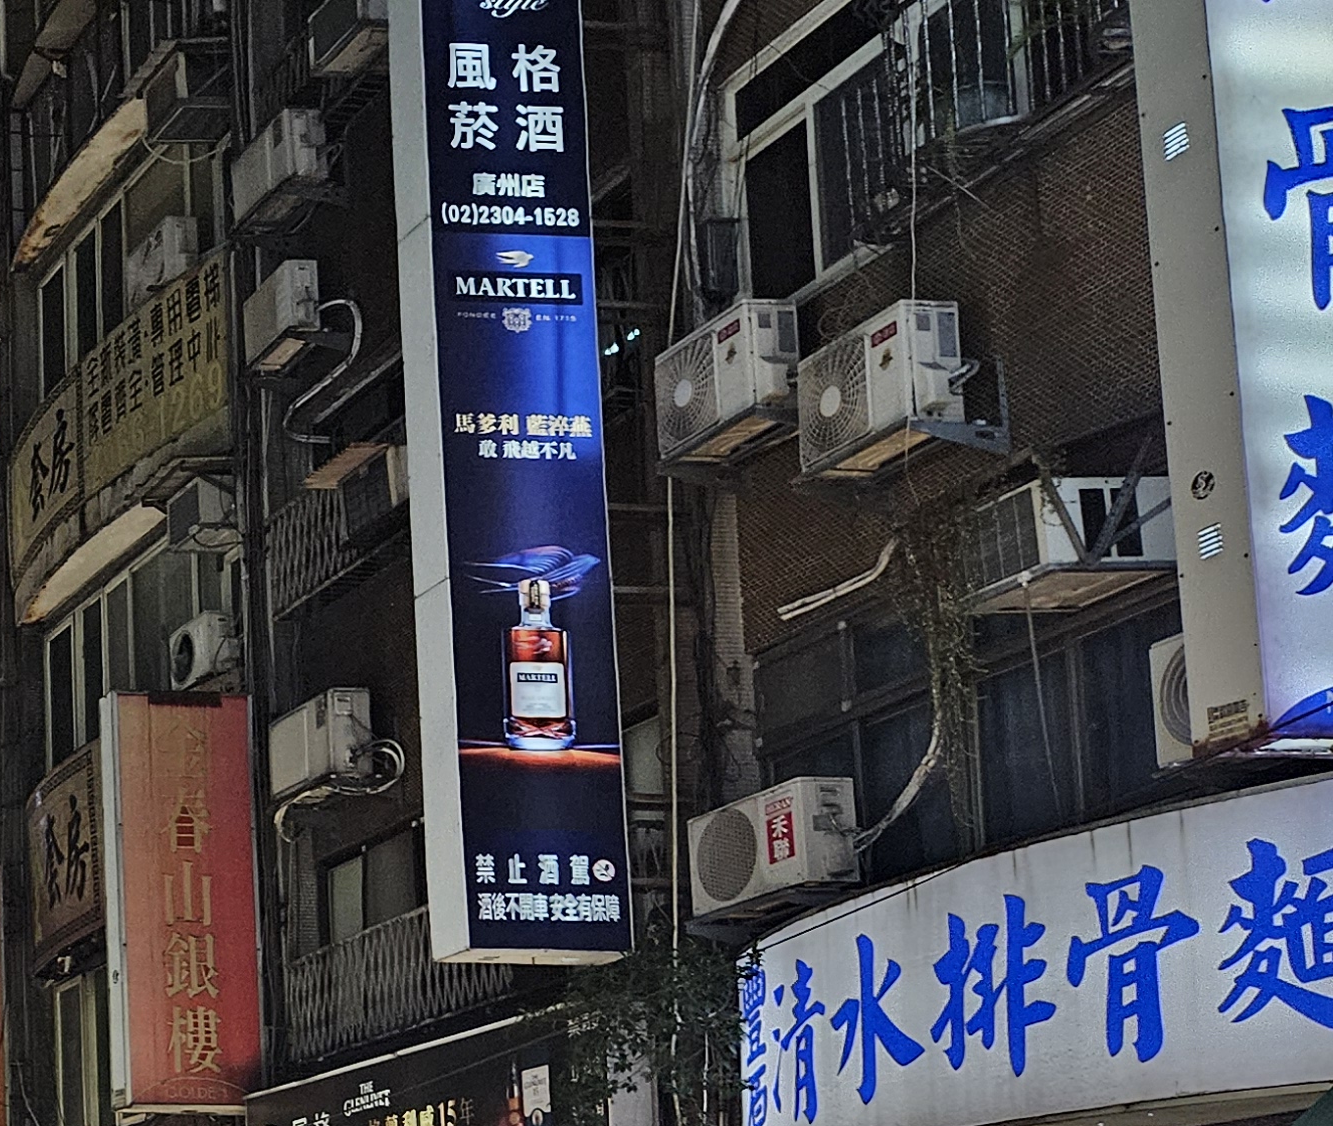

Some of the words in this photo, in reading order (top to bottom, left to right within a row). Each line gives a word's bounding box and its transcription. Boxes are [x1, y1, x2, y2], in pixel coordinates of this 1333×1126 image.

[448, 43, 561, 92] 風格
[448, 101, 565, 152] 菸酒
[473, 172, 545, 197] 廣州店
[442, 202, 580, 227] (02)2304-1528
[455, 276, 576, 300] MARTELL
[475, 853, 590, 885] 禁止酒駕
[359, 1080, 374, 1093] THE
